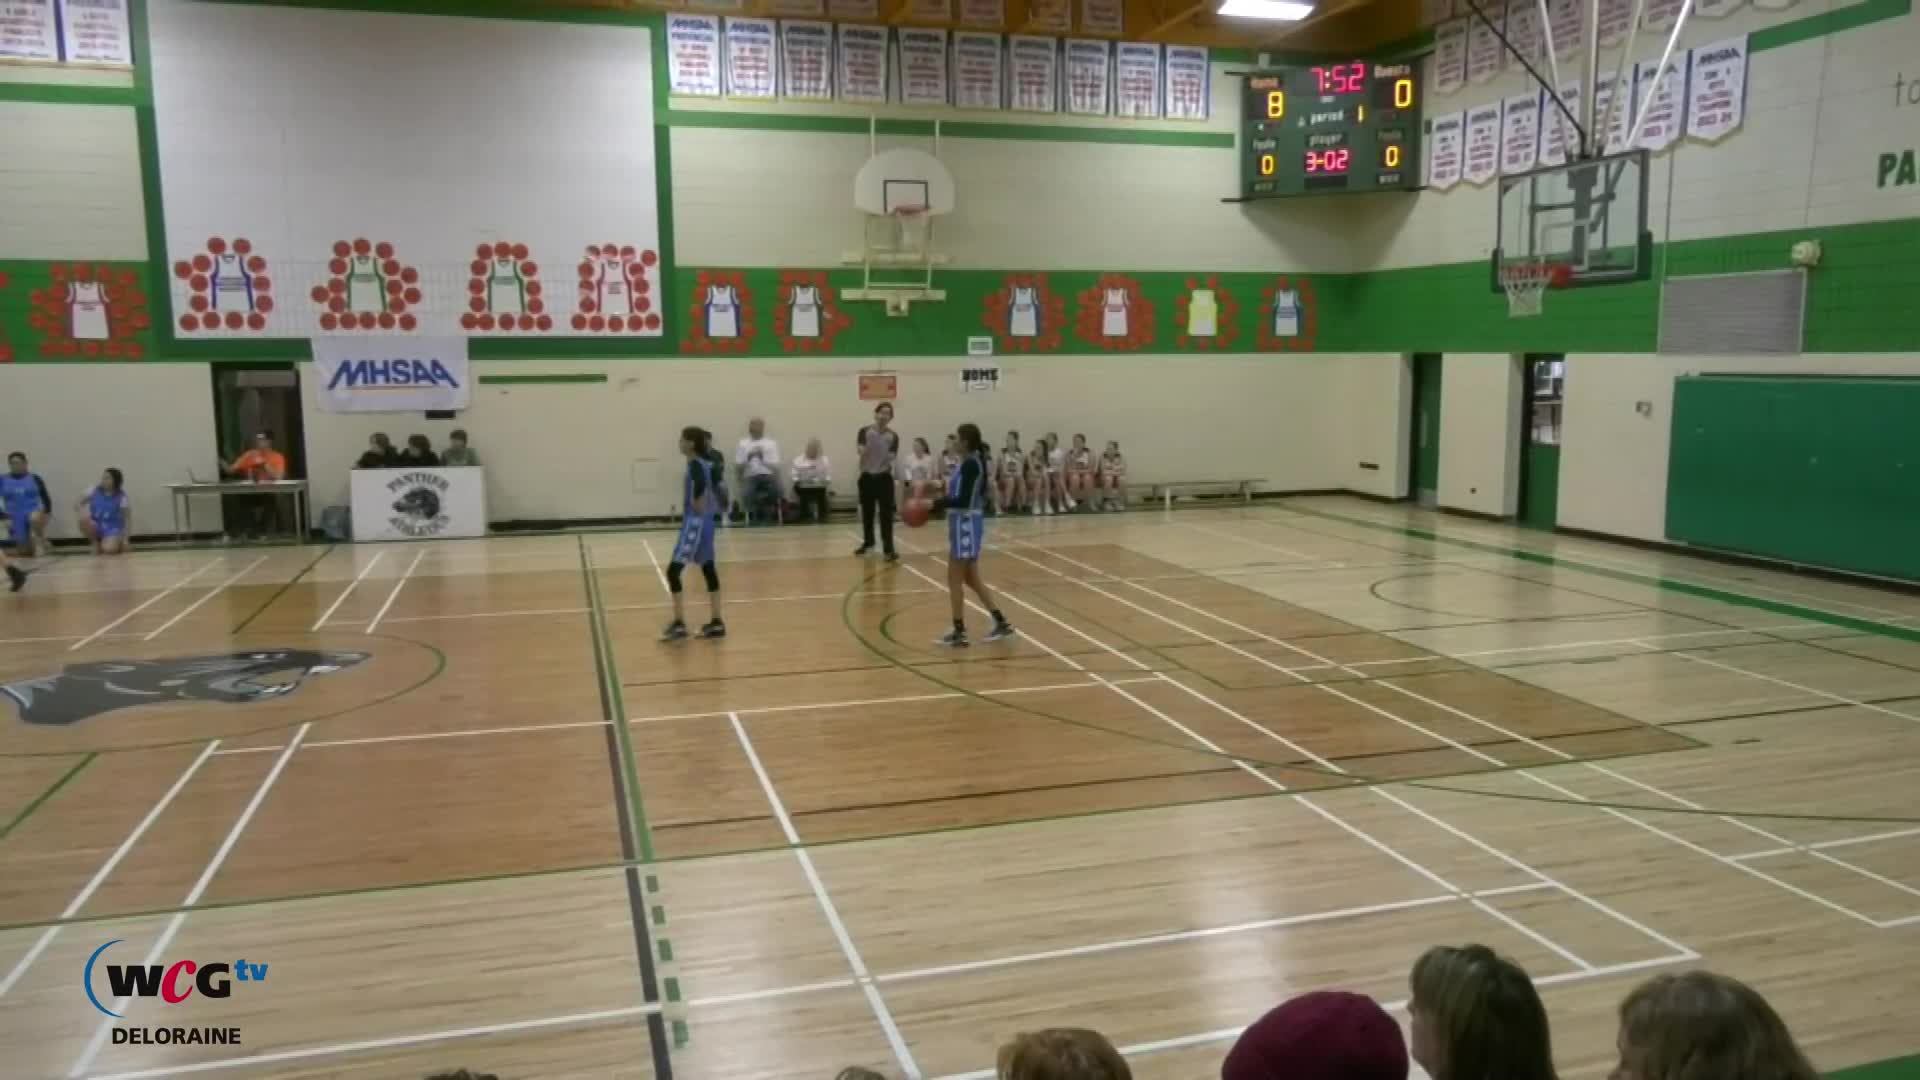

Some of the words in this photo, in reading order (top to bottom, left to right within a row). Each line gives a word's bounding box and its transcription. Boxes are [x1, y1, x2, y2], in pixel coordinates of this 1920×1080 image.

[1310, 63, 1364, 93] 7:52
[1268, 91, 1283, 118] 8
[1395, 79, 1411, 107] 0
[1310, 109, 1344, 125] period
[1262, 155, 1274, 175] 0
[1306, 149, 1349, 172] 3-02
[1386, 145, 1398, 167] 0
[1878, 149, 1920, 187] PA
[328, 359, 460, 390] MHSAA
